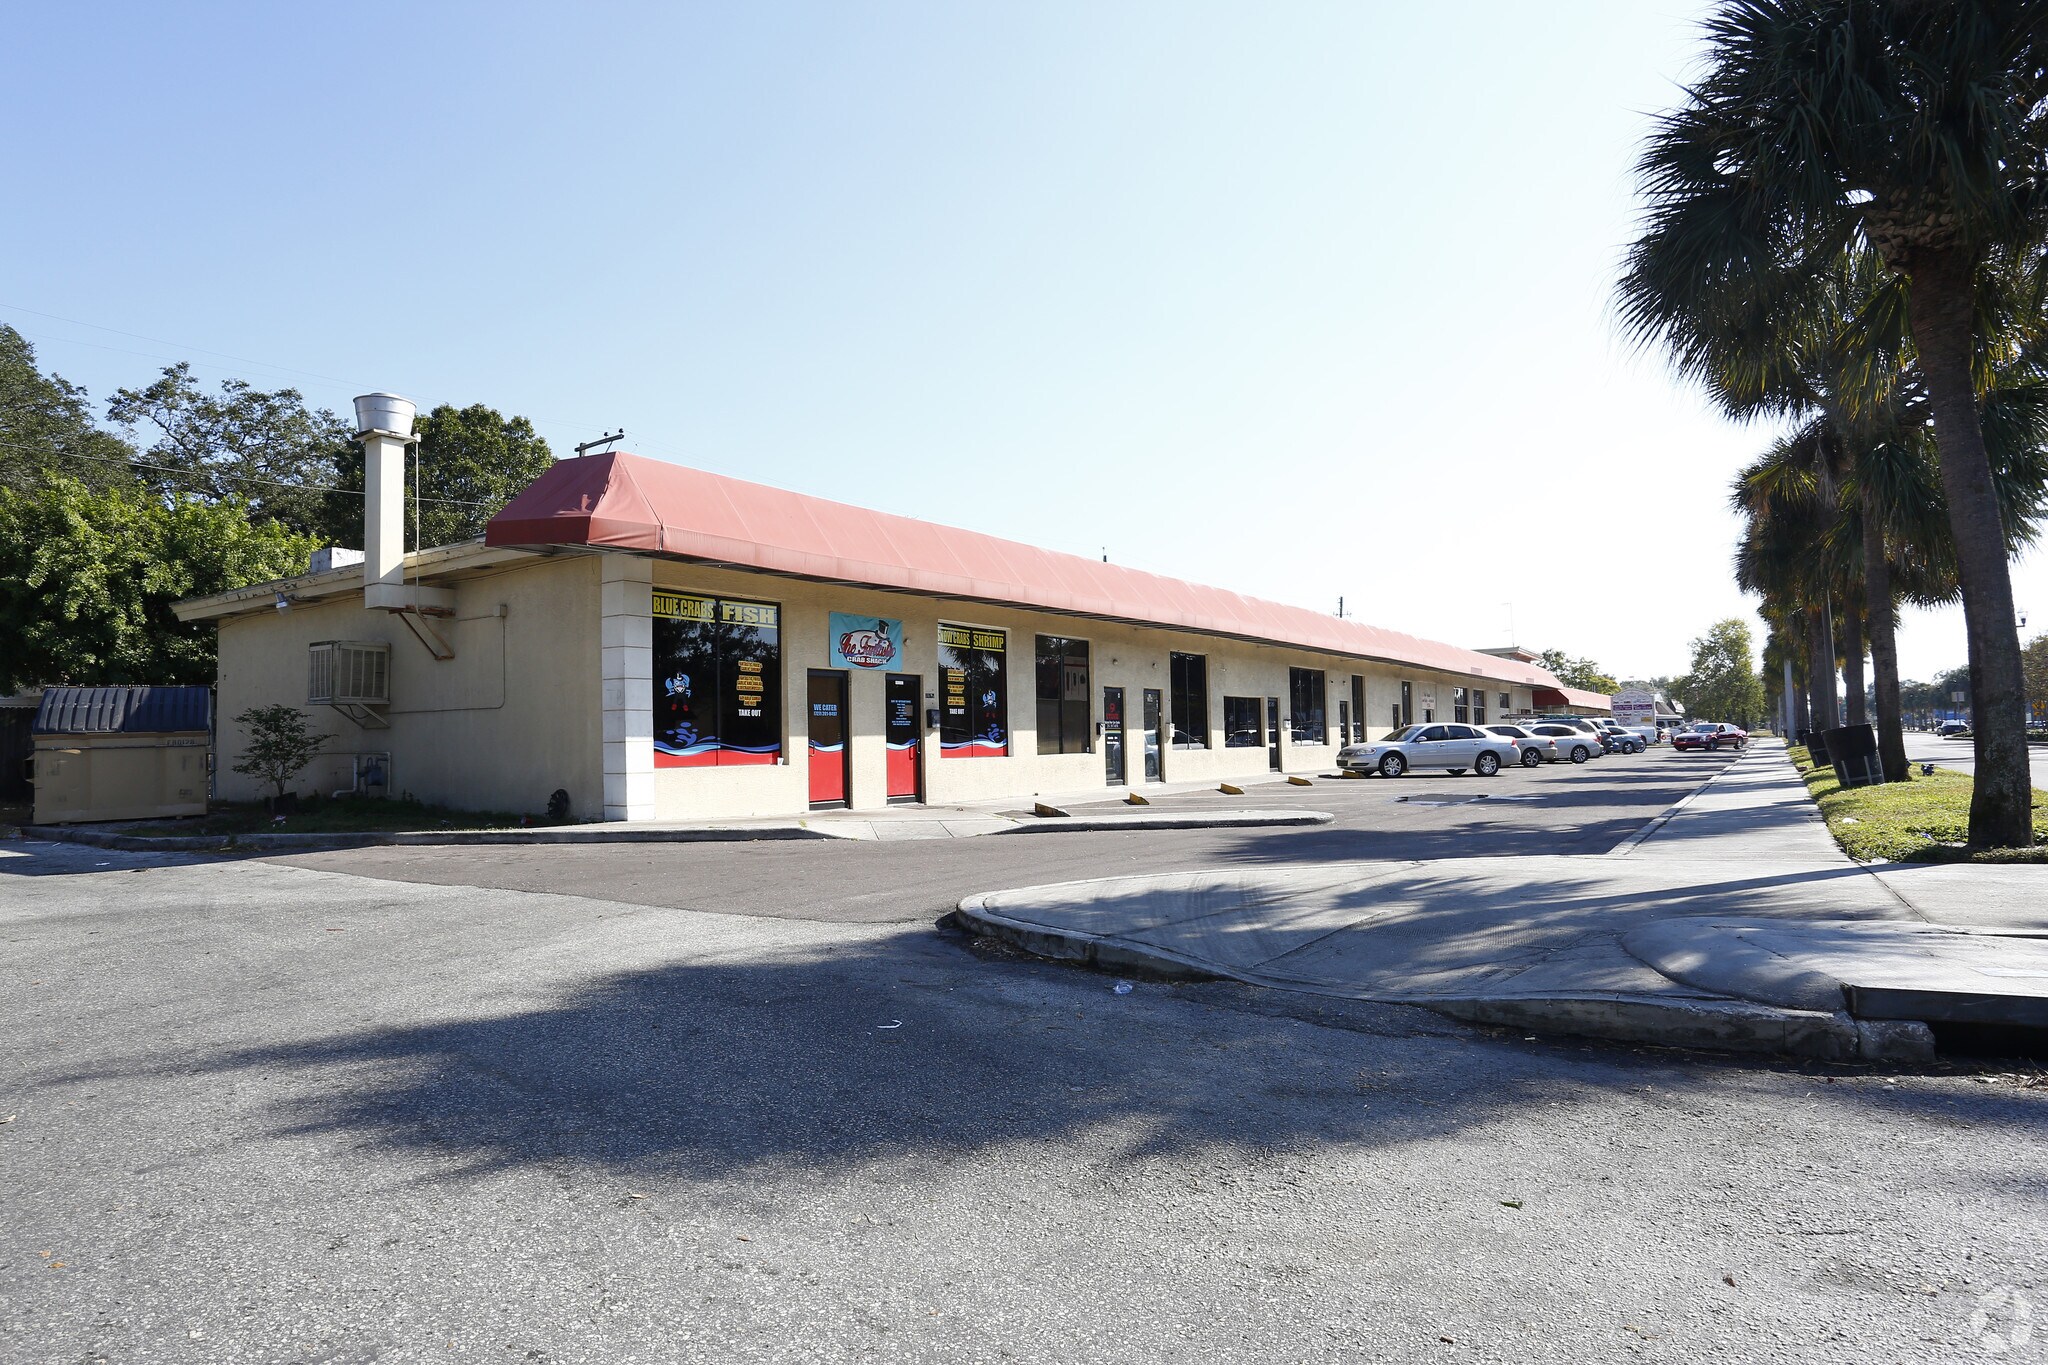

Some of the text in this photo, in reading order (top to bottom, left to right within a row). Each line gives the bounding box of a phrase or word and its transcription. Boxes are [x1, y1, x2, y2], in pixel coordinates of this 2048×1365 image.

[653, 596, 714, 619] BLUE CRABS
[722, 604, 775, 624] FISH
[953, 631, 970, 645] CRABS
[973, 634, 1004, 649] SHRIMP
[738, 708, 761, 717] TAKE OUT
[813, 703, 822, 711] WE
